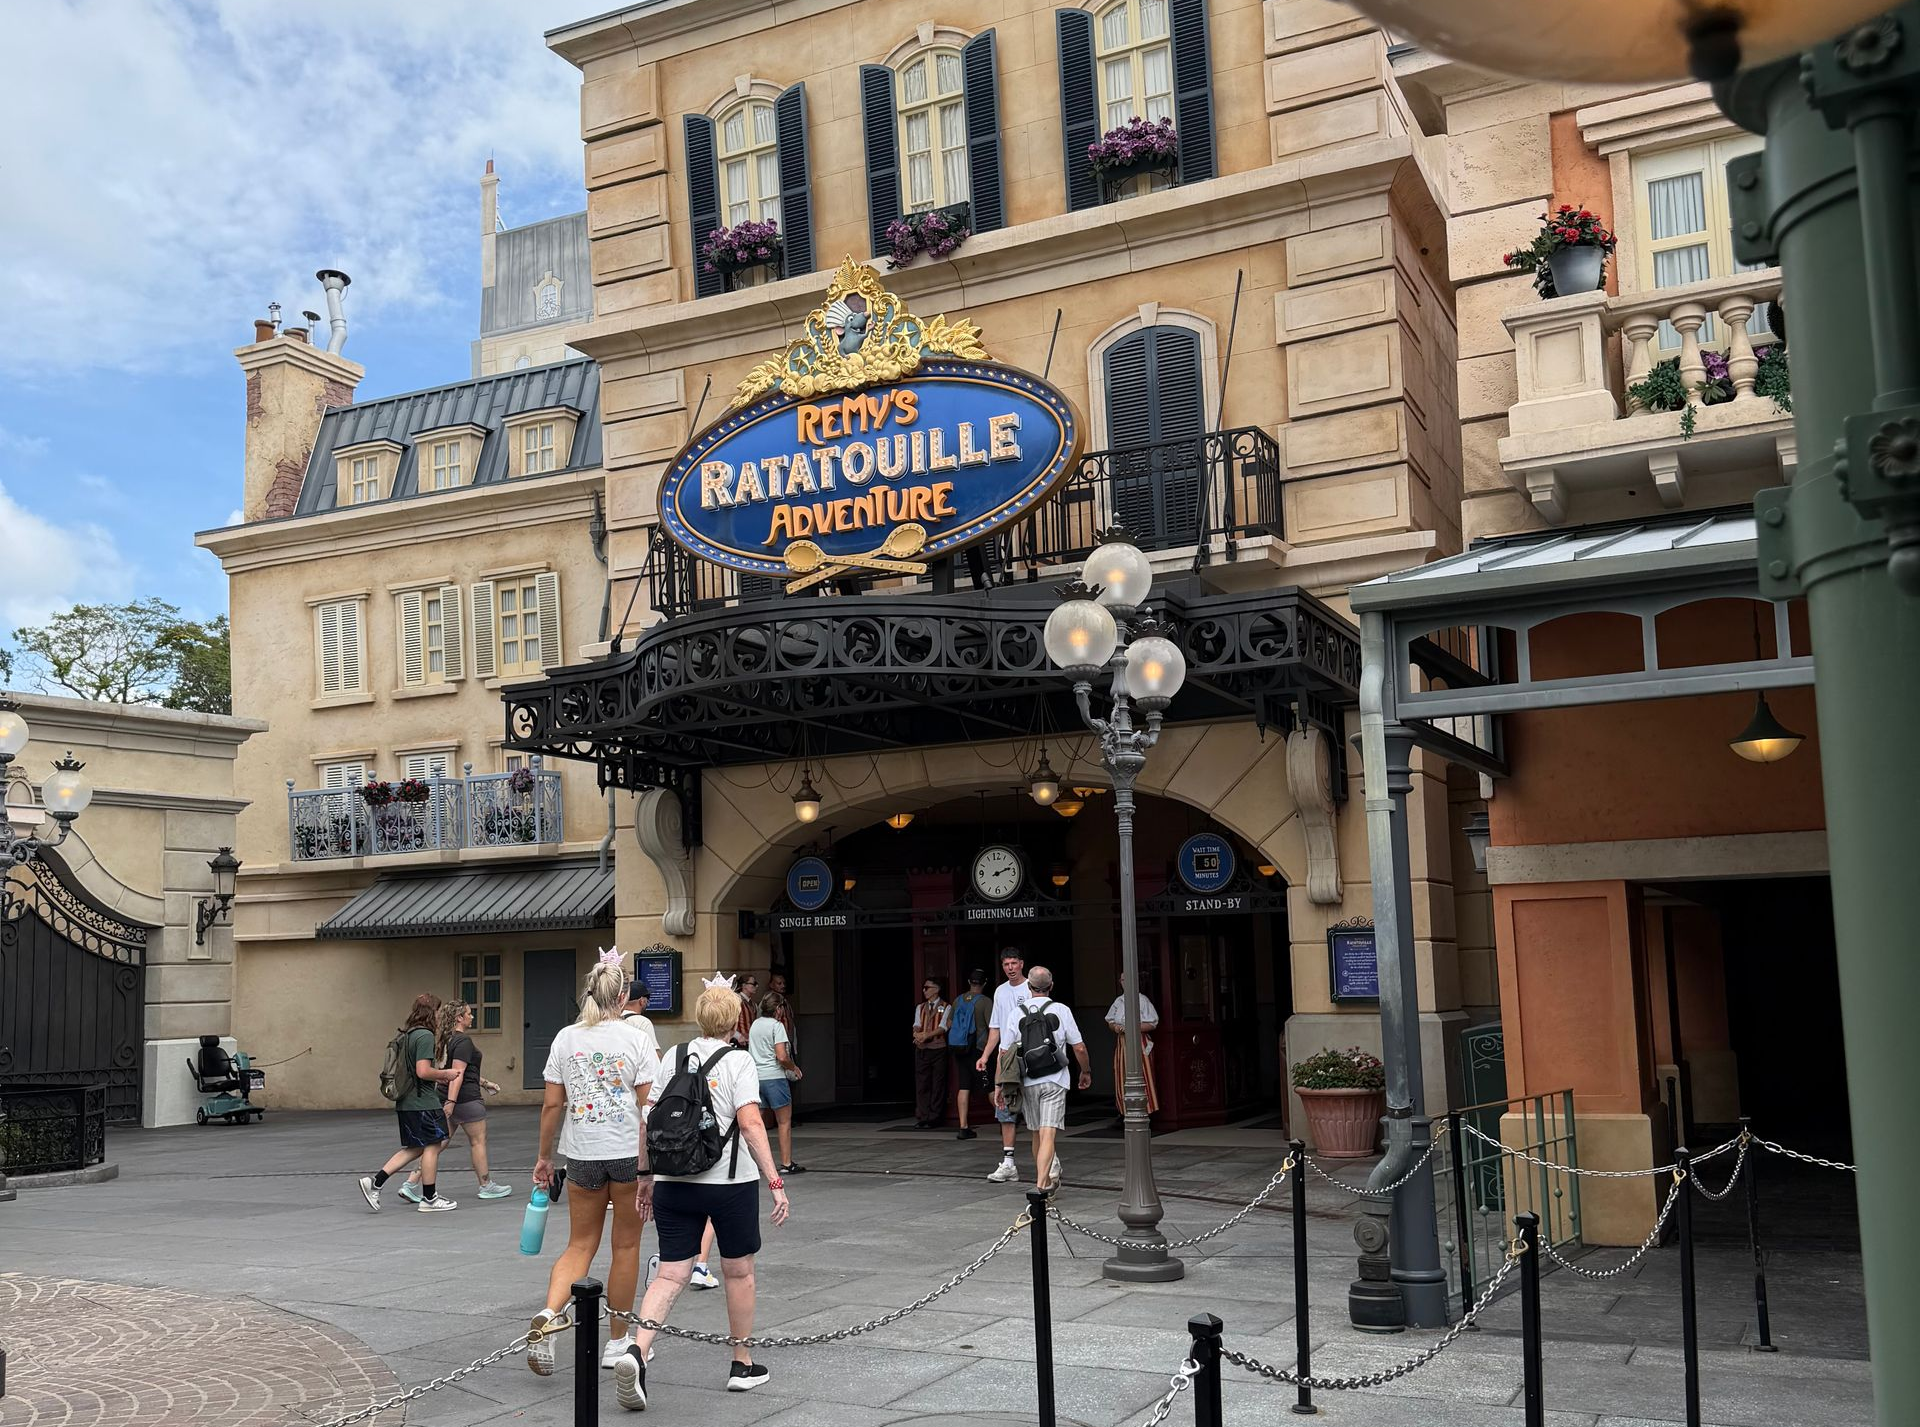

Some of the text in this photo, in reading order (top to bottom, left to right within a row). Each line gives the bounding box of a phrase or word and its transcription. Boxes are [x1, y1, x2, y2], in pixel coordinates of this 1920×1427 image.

[797, 389, 918, 446] REMY'S
[700, 412, 1022, 511] RATATOUILLE
[761, 481, 957, 546] ADVENTURE
[992, 852, 1001, 861] 12
[1204, 857, 1216, 867] 50
[978, 869, 985, 879] 9
[1011, 867, 1016, 877] 3
[802, 880, 819, 888] OPEN
[995, 885, 1001, 895] 6
[1185, 897, 1242, 911] STAND-BY
[967, 906, 1035, 920] LIGHTNING LANE
[779, 914, 847, 928] SINGLE RIDERS
